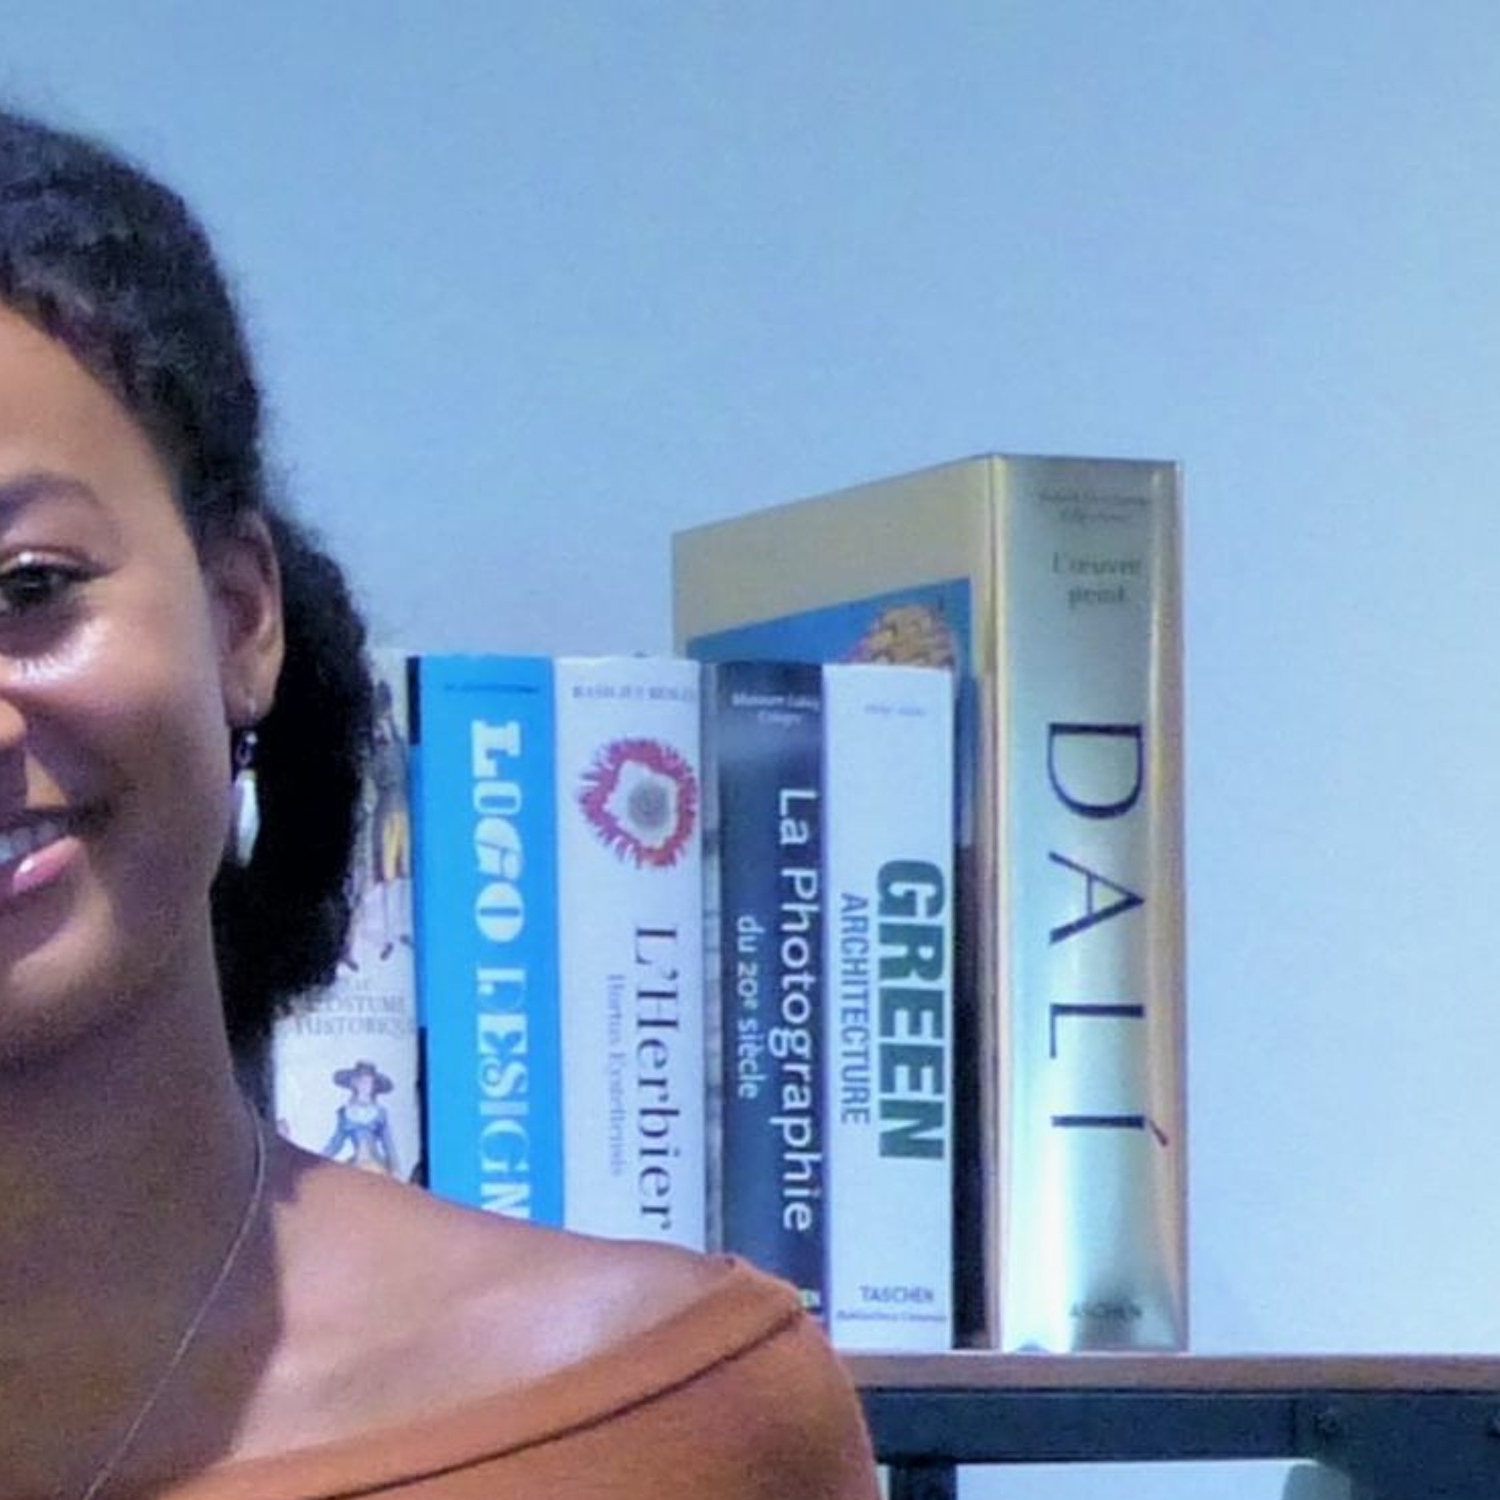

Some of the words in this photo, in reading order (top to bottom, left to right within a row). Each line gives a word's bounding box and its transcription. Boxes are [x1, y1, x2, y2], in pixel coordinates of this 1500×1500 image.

[469, 719, 525, 943] LOGO
[778, 788, 818, 846] La
[737, 915, 766, 953] du
[841, 892, 871, 1125] ARCHITECTURE
[876, 859, 945, 1161] GREEN
[476, 966, 532, 1219] DESIGN
[633, 924, 682, 1234] L'Herbier
[737, 1017, 767, 1099] siècle
[768, 867, 823, 1232] Photographie
[859, 1285, 934, 1303] TASCHEN
